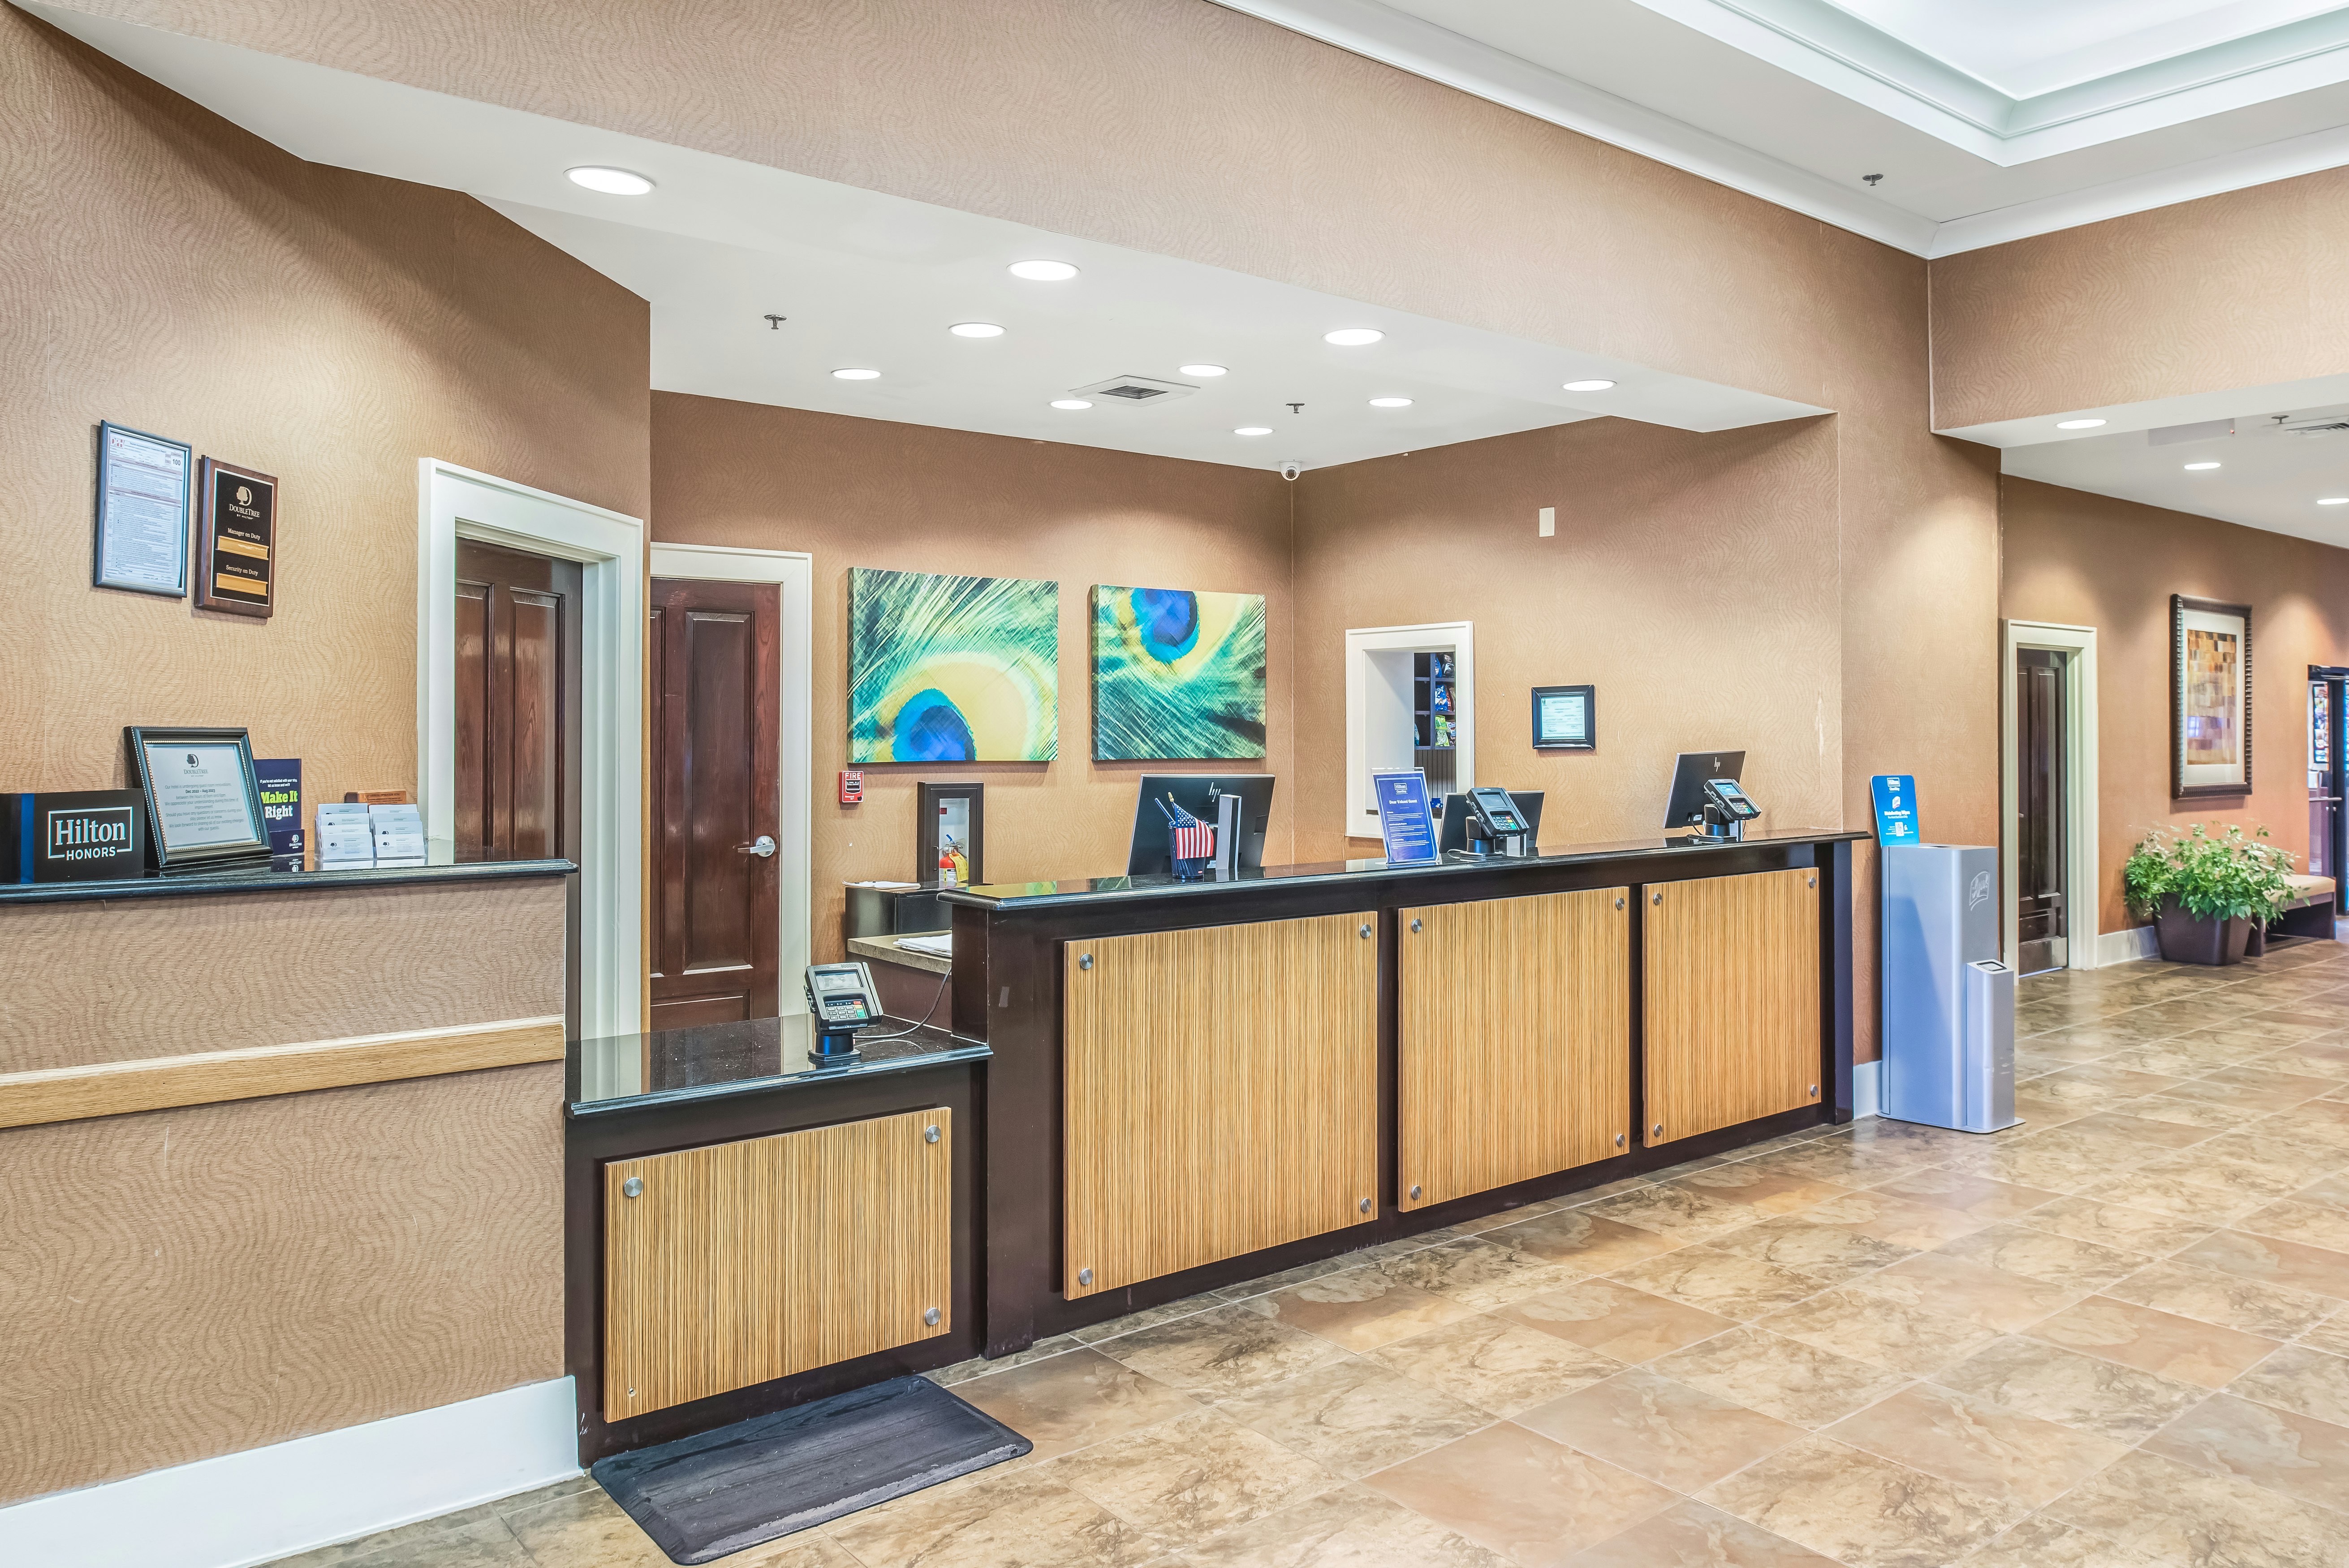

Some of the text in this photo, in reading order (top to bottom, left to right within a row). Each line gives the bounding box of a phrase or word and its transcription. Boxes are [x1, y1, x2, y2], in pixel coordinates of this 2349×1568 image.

[228, 528, 245, 537] Manager
[251, 533, 261, 541] Duty
[226, 564, 242, 573] Security
[1714, 757, 1721, 772] hp
[260, 790, 298, 804] Make It
[1208, 782, 1221, 802] hp
[264, 805, 293, 820] Right
[55, 818, 126, 845] Hilton
[65, 846, 116, 861] HONORS
